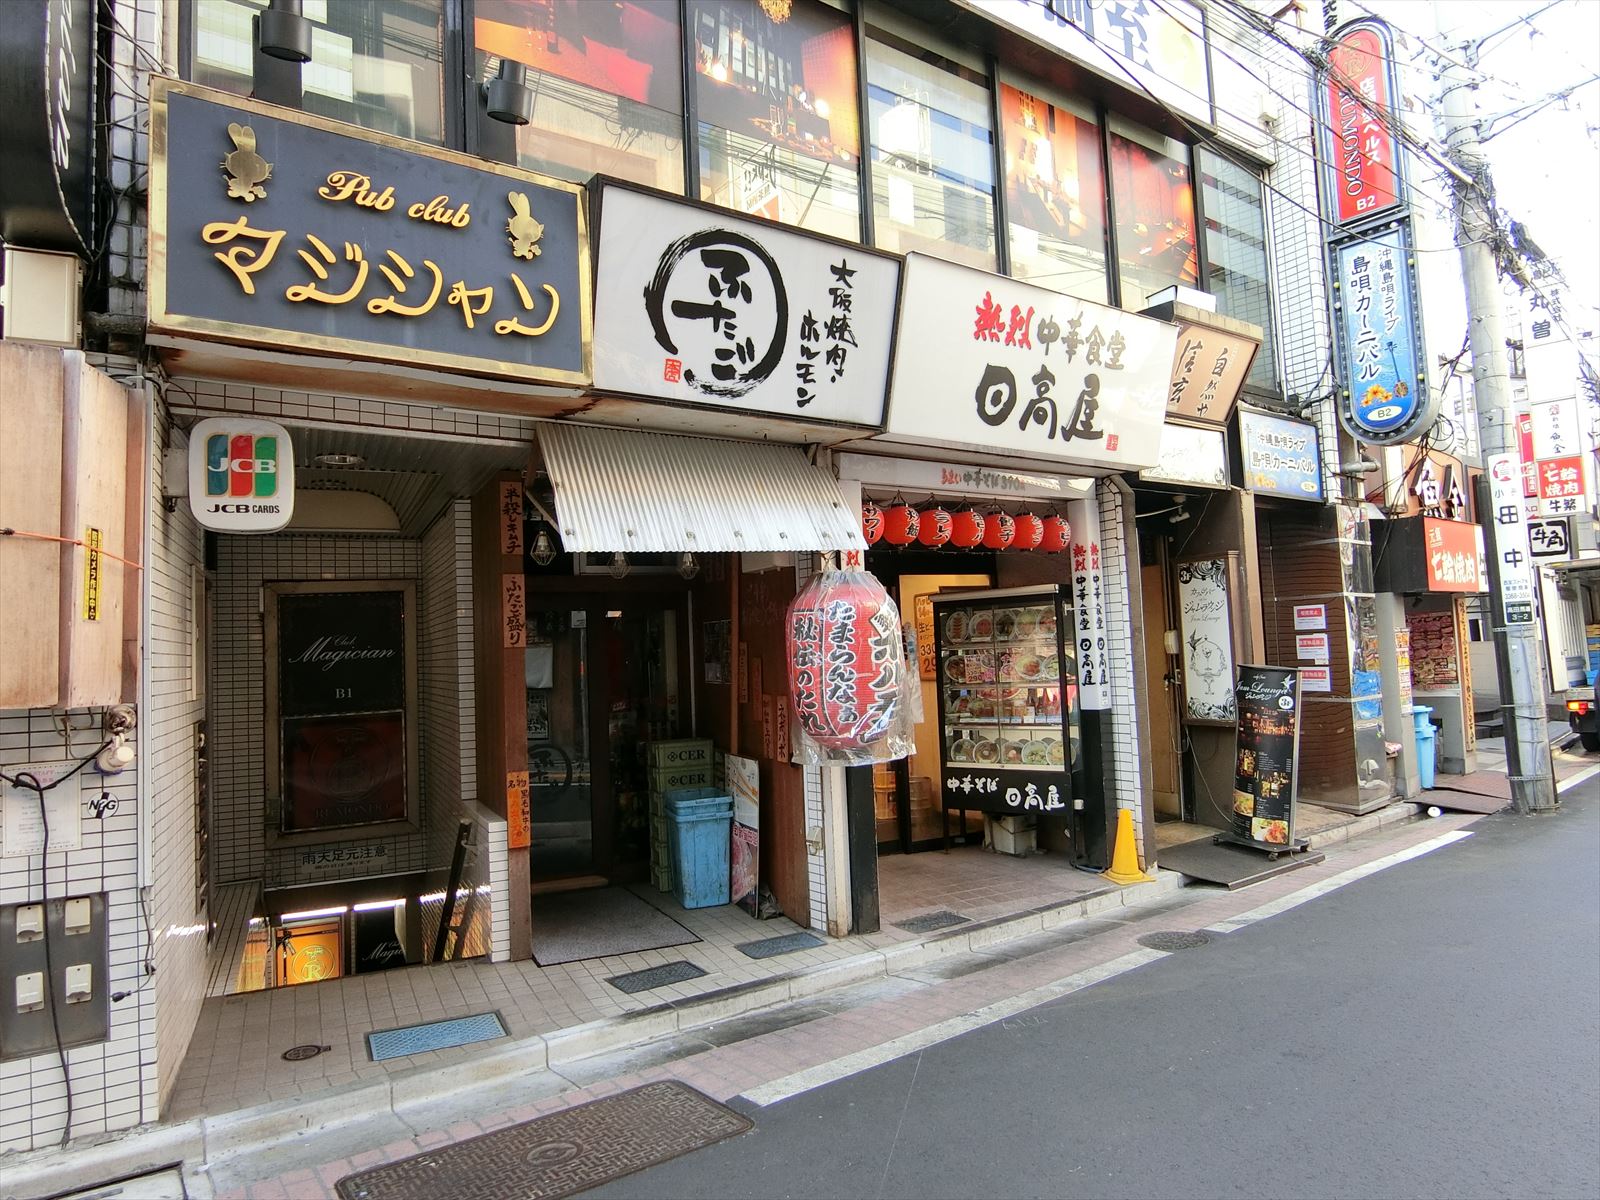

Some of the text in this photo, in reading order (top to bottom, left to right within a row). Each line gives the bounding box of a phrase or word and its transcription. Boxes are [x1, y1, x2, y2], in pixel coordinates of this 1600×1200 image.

[318, 171, 471, 229] Pub club
[1356, 195, 1376, 212] B2
[202, 215, 560, 338] マジシャン
[1378, 247, 1401, 337] 沖縄島唄ライブ
[670, 248, 757, 381] ふたご
[973, 291, 1127, 371] 熱烈中華食堂
[1350, 255, 1382, 381] 島唄カーニバル
[796, 309, 821, 408] ホルモン
[974, 363, 1105, 442] 日高屋
[1376, 408, 1393, 419] B2
[208, 457, 277, 474] JCB
[1251, 451, 1316, 474] 島唄カーニバル
[207, 503, 281, 514] JCB CARDS
[502, 487, 522, 554] 半殺しキムチ
[863, 506, 881, 539] サワー
[1531, 527, 1564, 548] 牛角
[505, 579, 526, 646] ふたご盛り
[287, 636, 397, 672] Magician
[793, 614, 827, 732] 秘伝のたれ
[1079, 637, 1097, 687] 日高屋
[335, 687, 353, 699] B1
[946, 774, 1000, 795] 中華そば
[1004, 782, 1065, 811] 日高屋
[302, 844, 388, 866] 雨天足元注意
